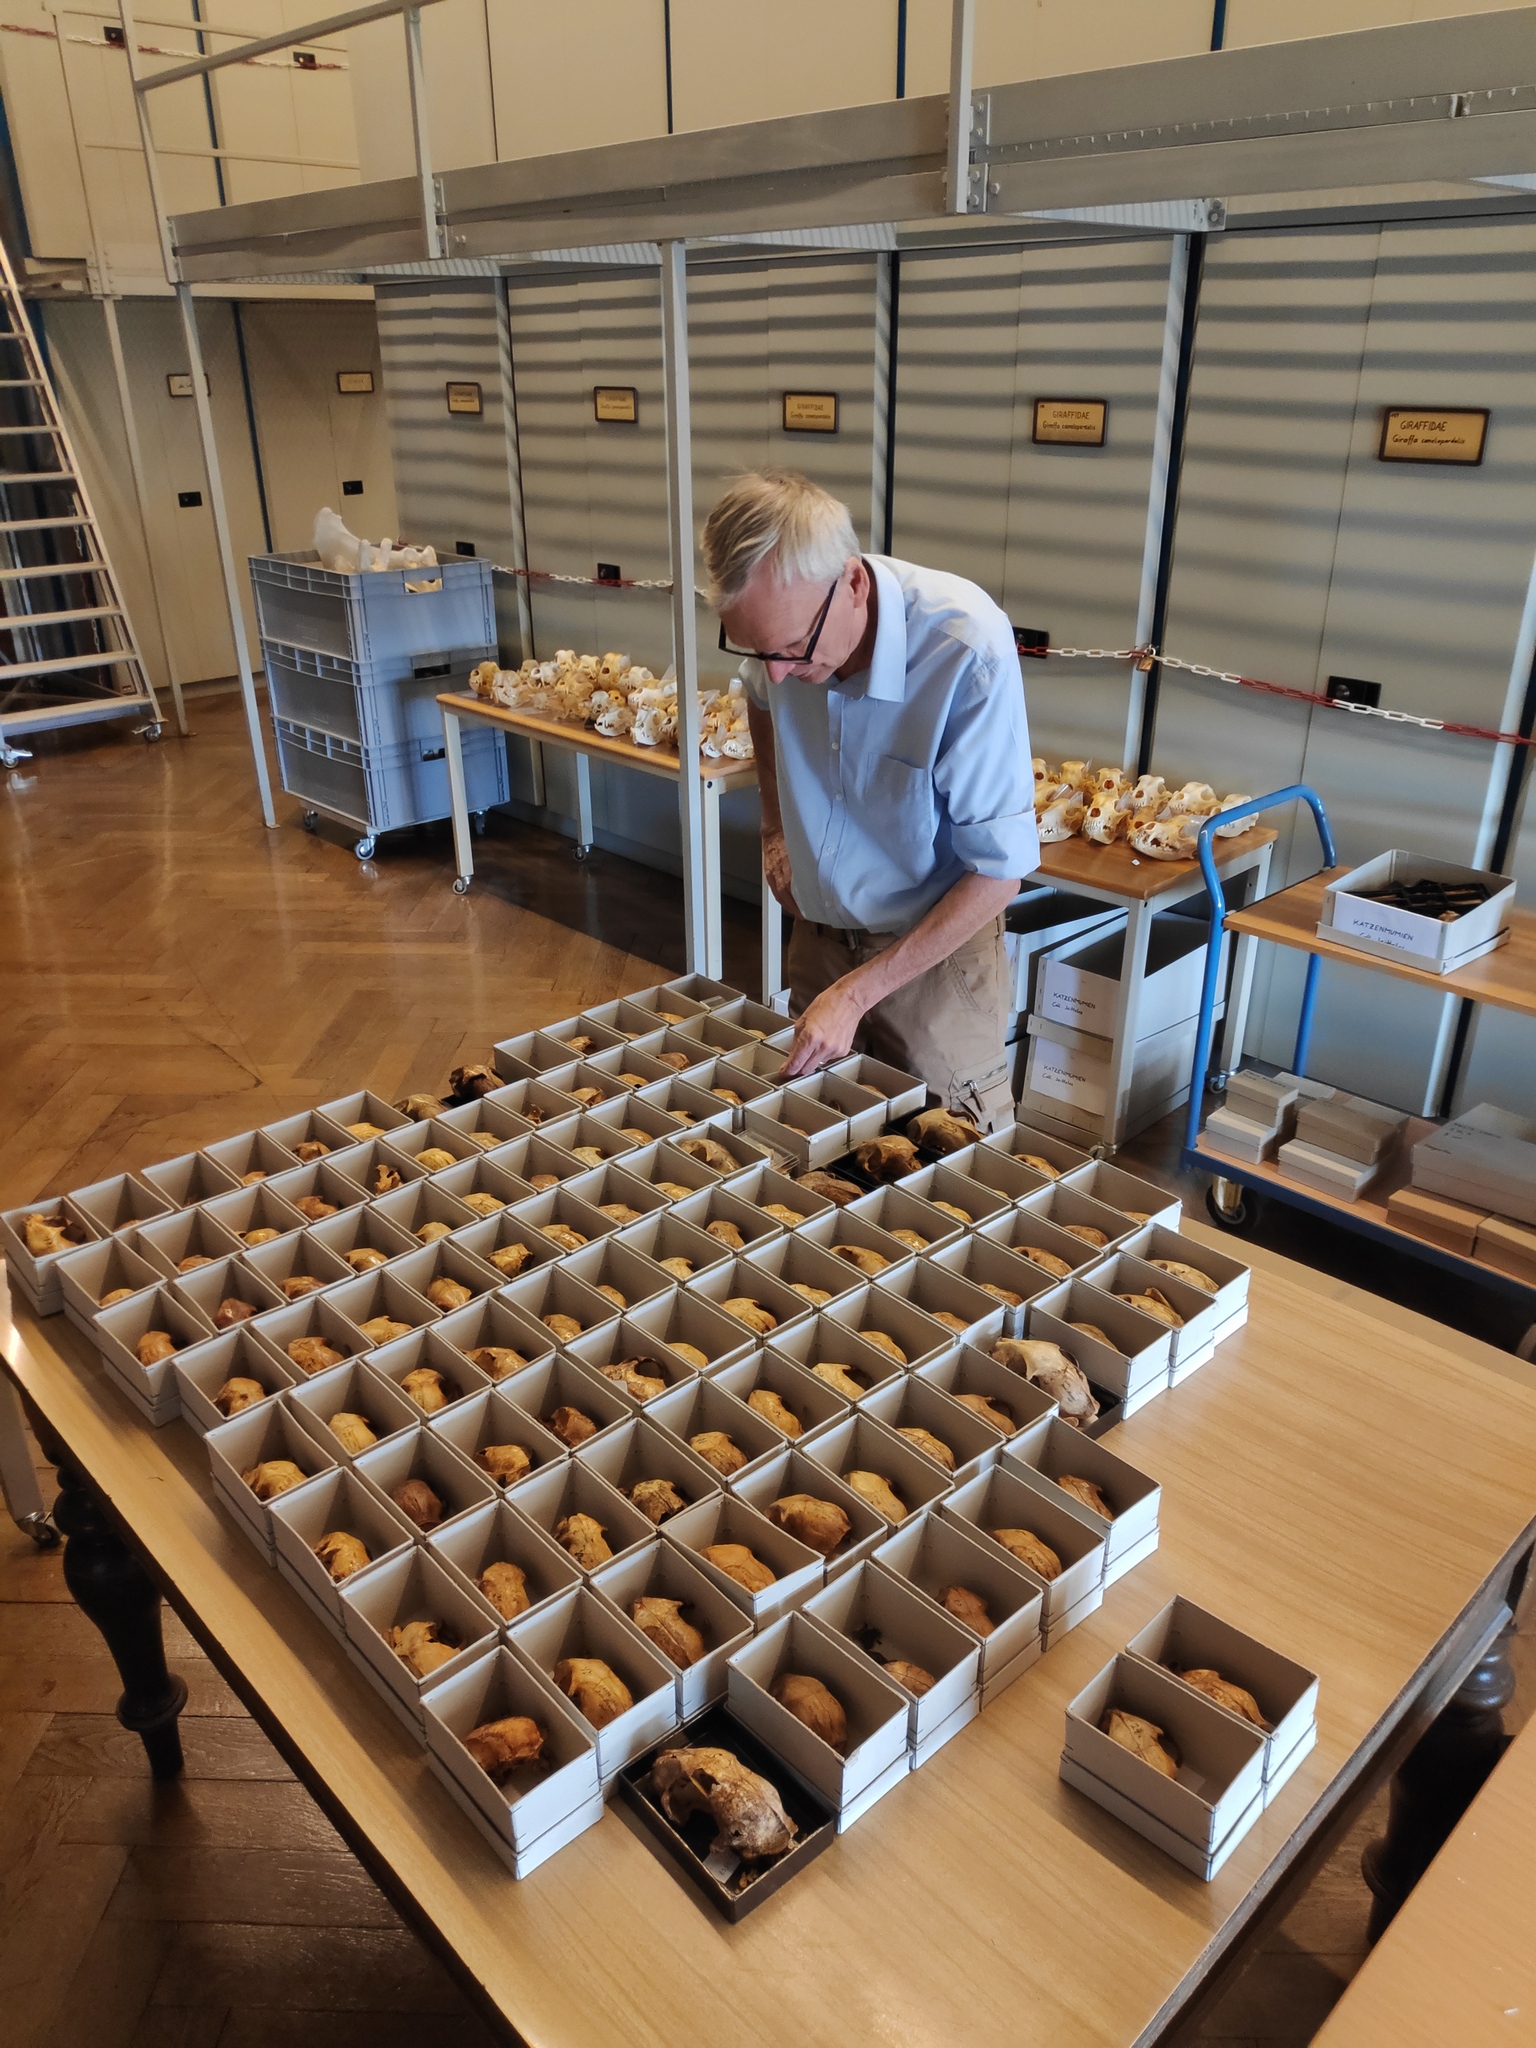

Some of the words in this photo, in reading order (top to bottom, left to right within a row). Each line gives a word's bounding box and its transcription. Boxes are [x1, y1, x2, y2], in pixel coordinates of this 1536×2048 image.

[1052, 410, 1090, 420] GIRAFFIDAE
[1042, 420, 1060, 430] Giraffa
[1400, 420, 1448, 432] GIRAFFIDAE
[1392, 434, 1419, 446] Giraffa
[1421, 436, 1466, 446] camelopardalis
[1352, 919, 1414, 942] KATZENMUMIEN
[1052, 992, 1096, 1010] KATZENMUMIEN
[1043, 1064, 1086, 1083] KATZENMUMIEN
